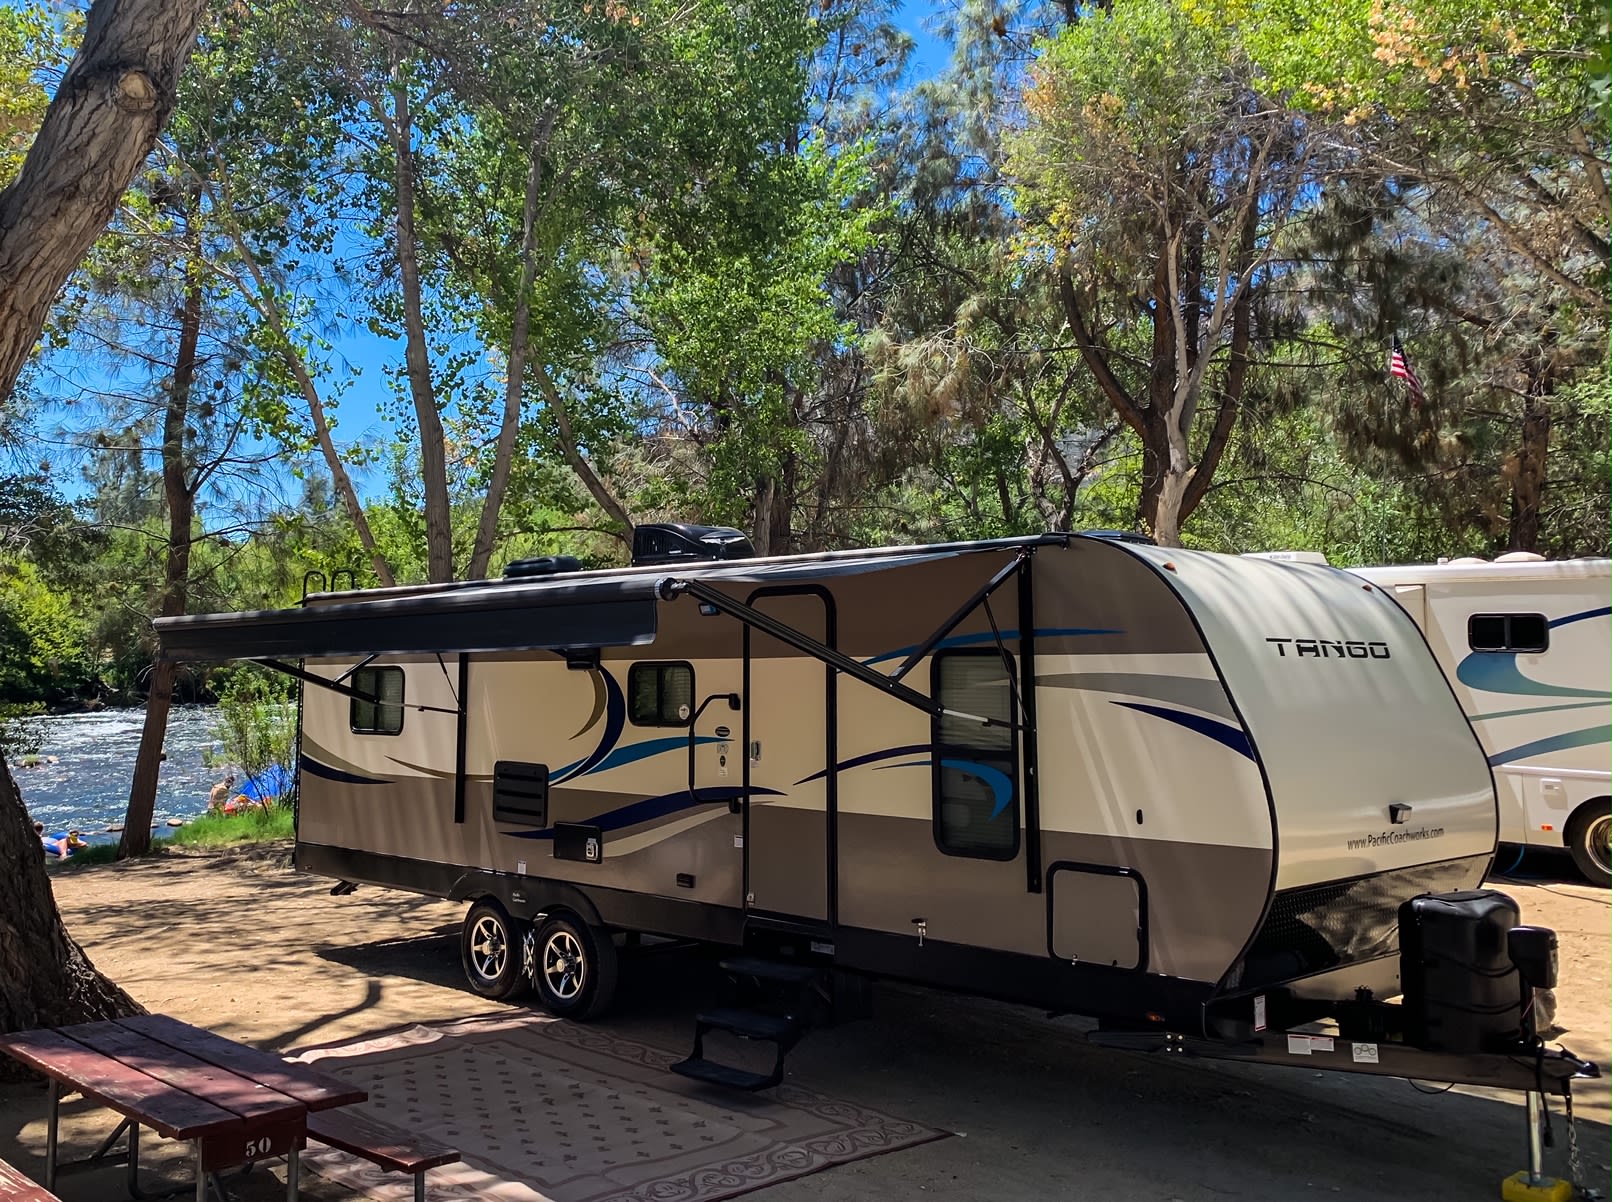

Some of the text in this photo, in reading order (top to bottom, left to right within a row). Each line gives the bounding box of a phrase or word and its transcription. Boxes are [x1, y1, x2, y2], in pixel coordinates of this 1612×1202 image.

[1266, 638, 1391, 659] TANGO
[1347, 827, 1445, 850] www.PacificCoachworks.com
[245, 1137, 271, 1157] 50
